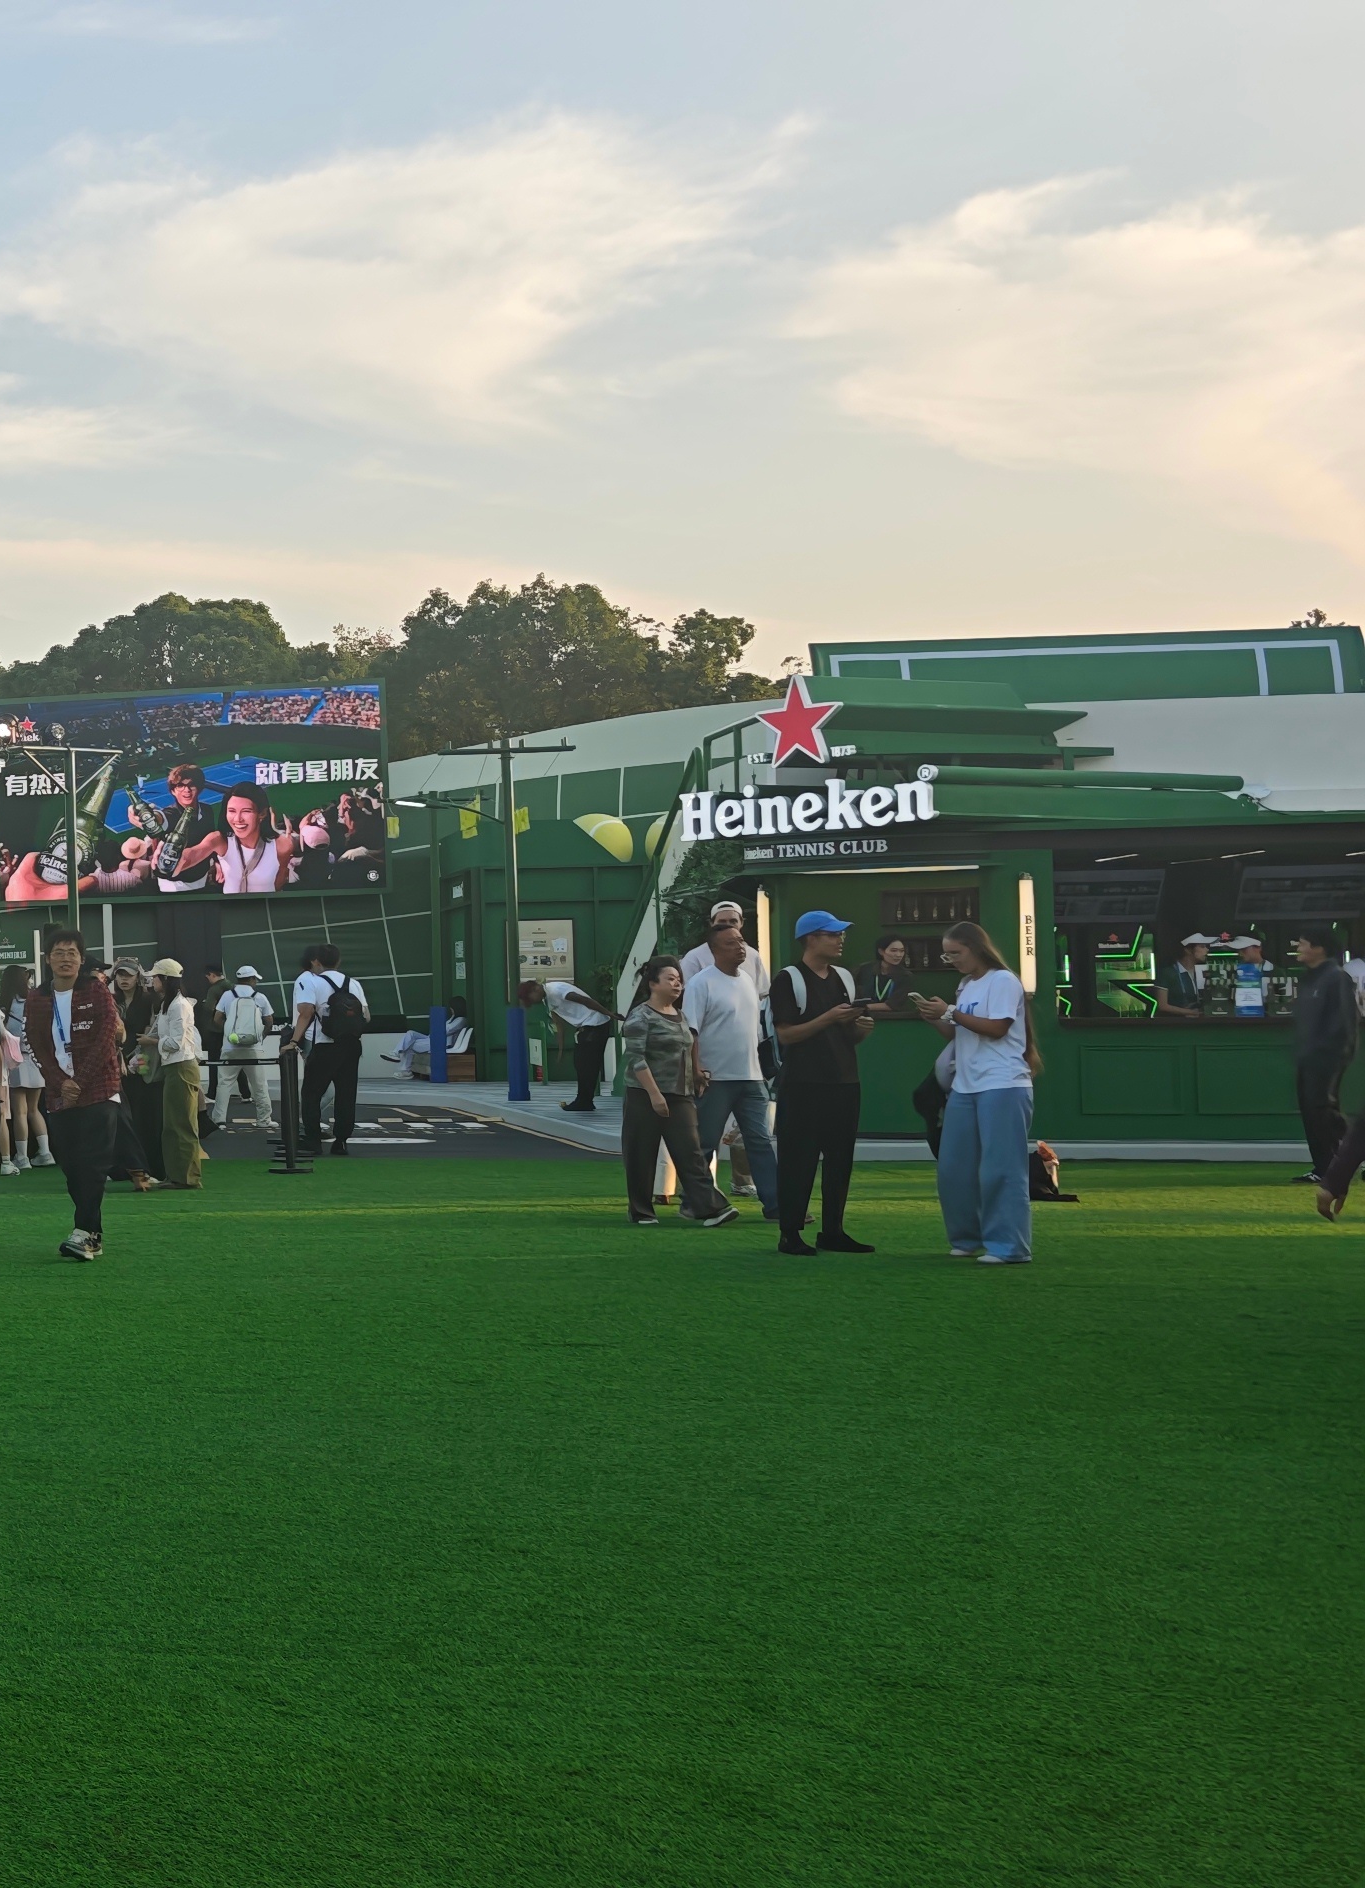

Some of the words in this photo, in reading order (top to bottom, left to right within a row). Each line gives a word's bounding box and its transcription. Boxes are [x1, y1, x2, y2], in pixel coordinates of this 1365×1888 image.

[830, 744, 856, 757] 1873
[255, 758, 380, 786] 就有星朋友
[679, 778, 940, 842] Heineken
[776, 841, 835, 858] TENNIS
[839, 839, 888, 855] CLUB
[1024, 914, 1034, 956] BEER
